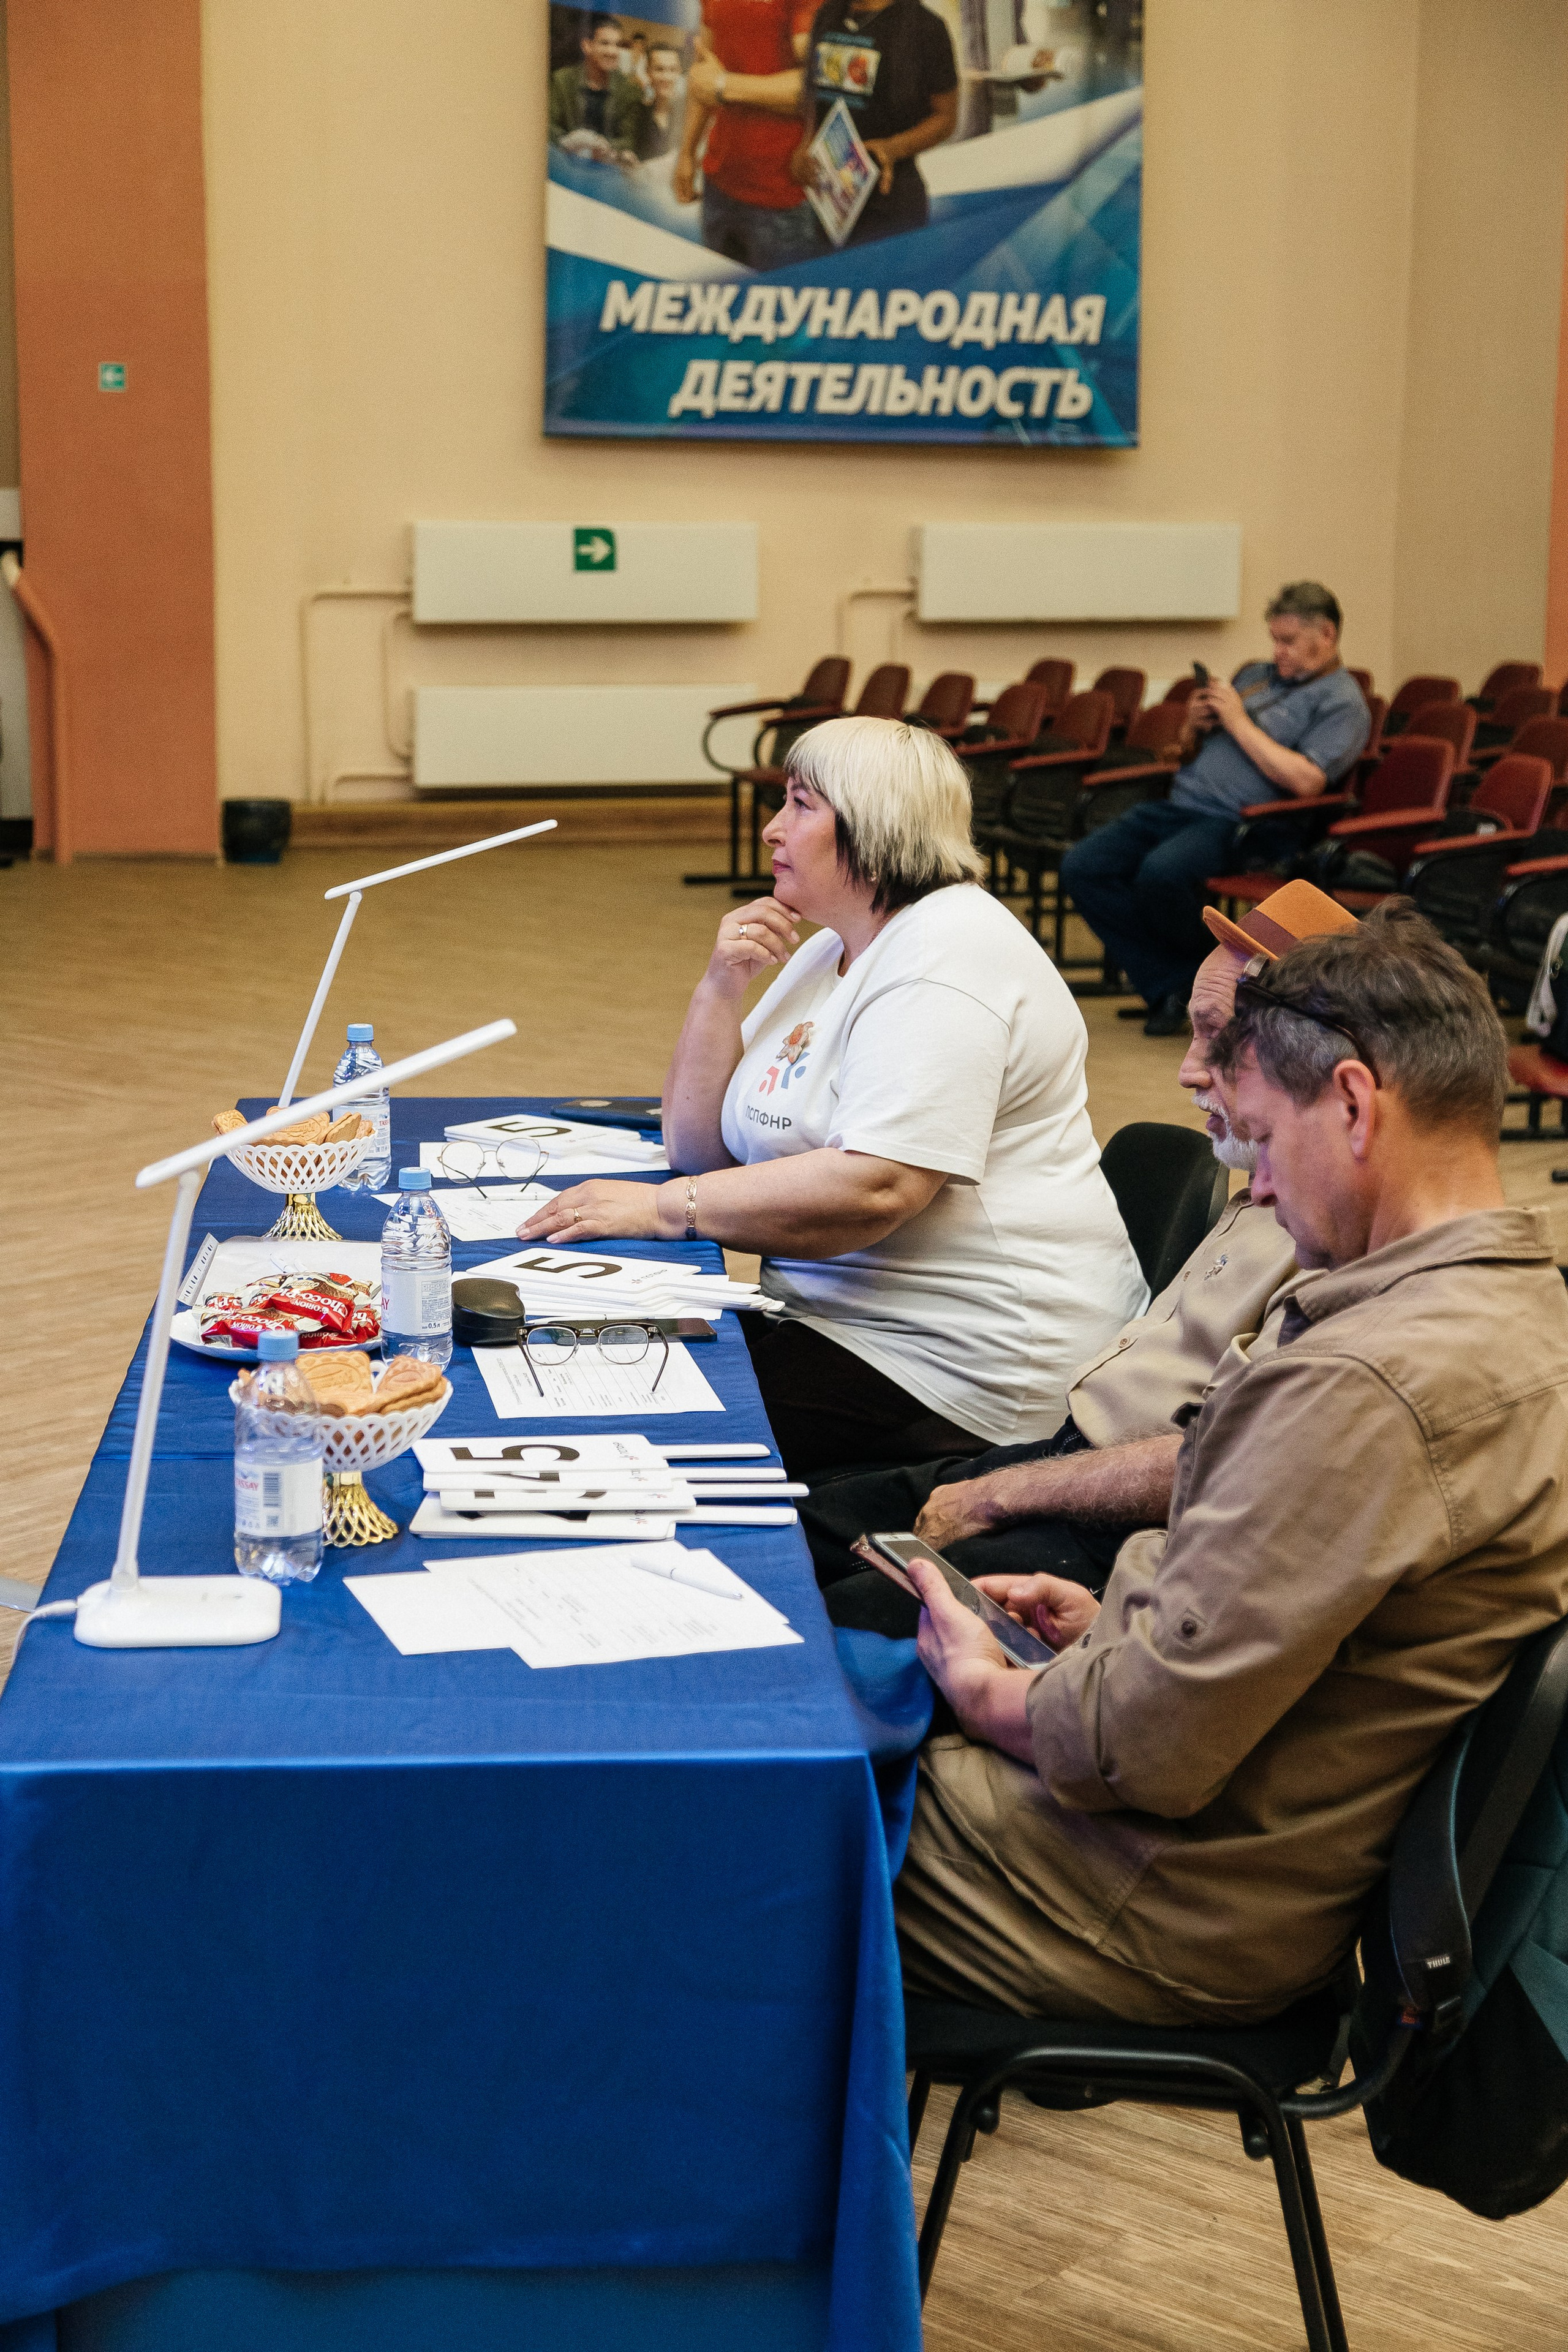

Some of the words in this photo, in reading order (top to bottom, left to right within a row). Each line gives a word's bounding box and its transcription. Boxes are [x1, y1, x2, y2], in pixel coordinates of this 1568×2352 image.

[600, 279, 1107, 347] МЕЖДУНАРОДНАЯ
[668, 358, 1093, 420] ДЕЯТЕЛЬНОСТЬ
[745, 1105, 793, 1130] ПСПФНР
[486, 1121, 572, 1137] 5
[513, 1256, 623, 1279] 5
[294, 1299, 318, 1311] ORION
[230, 1322, 255, 1330] ORION
[449, 1444, 580, 1461] 5
[1427, 1956, 1450, 1969] THULE
